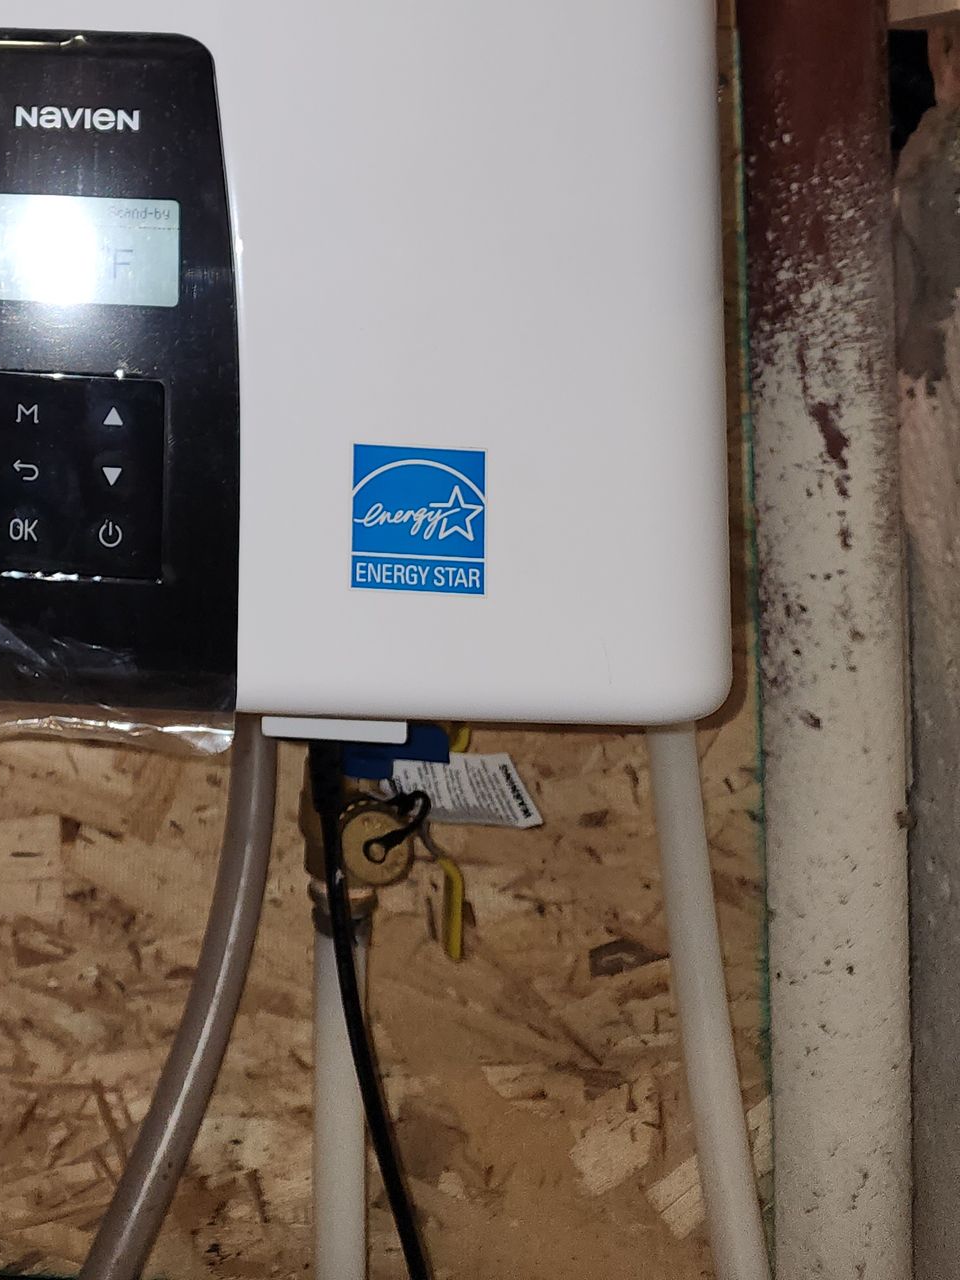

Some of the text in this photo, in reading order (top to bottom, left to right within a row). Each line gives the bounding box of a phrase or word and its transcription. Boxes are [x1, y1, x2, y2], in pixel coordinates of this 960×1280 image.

[15, 403, 40, 424] M
[9, 517, 38, 542] OK
[355, 562, 481, 589] ENERGY STAR
